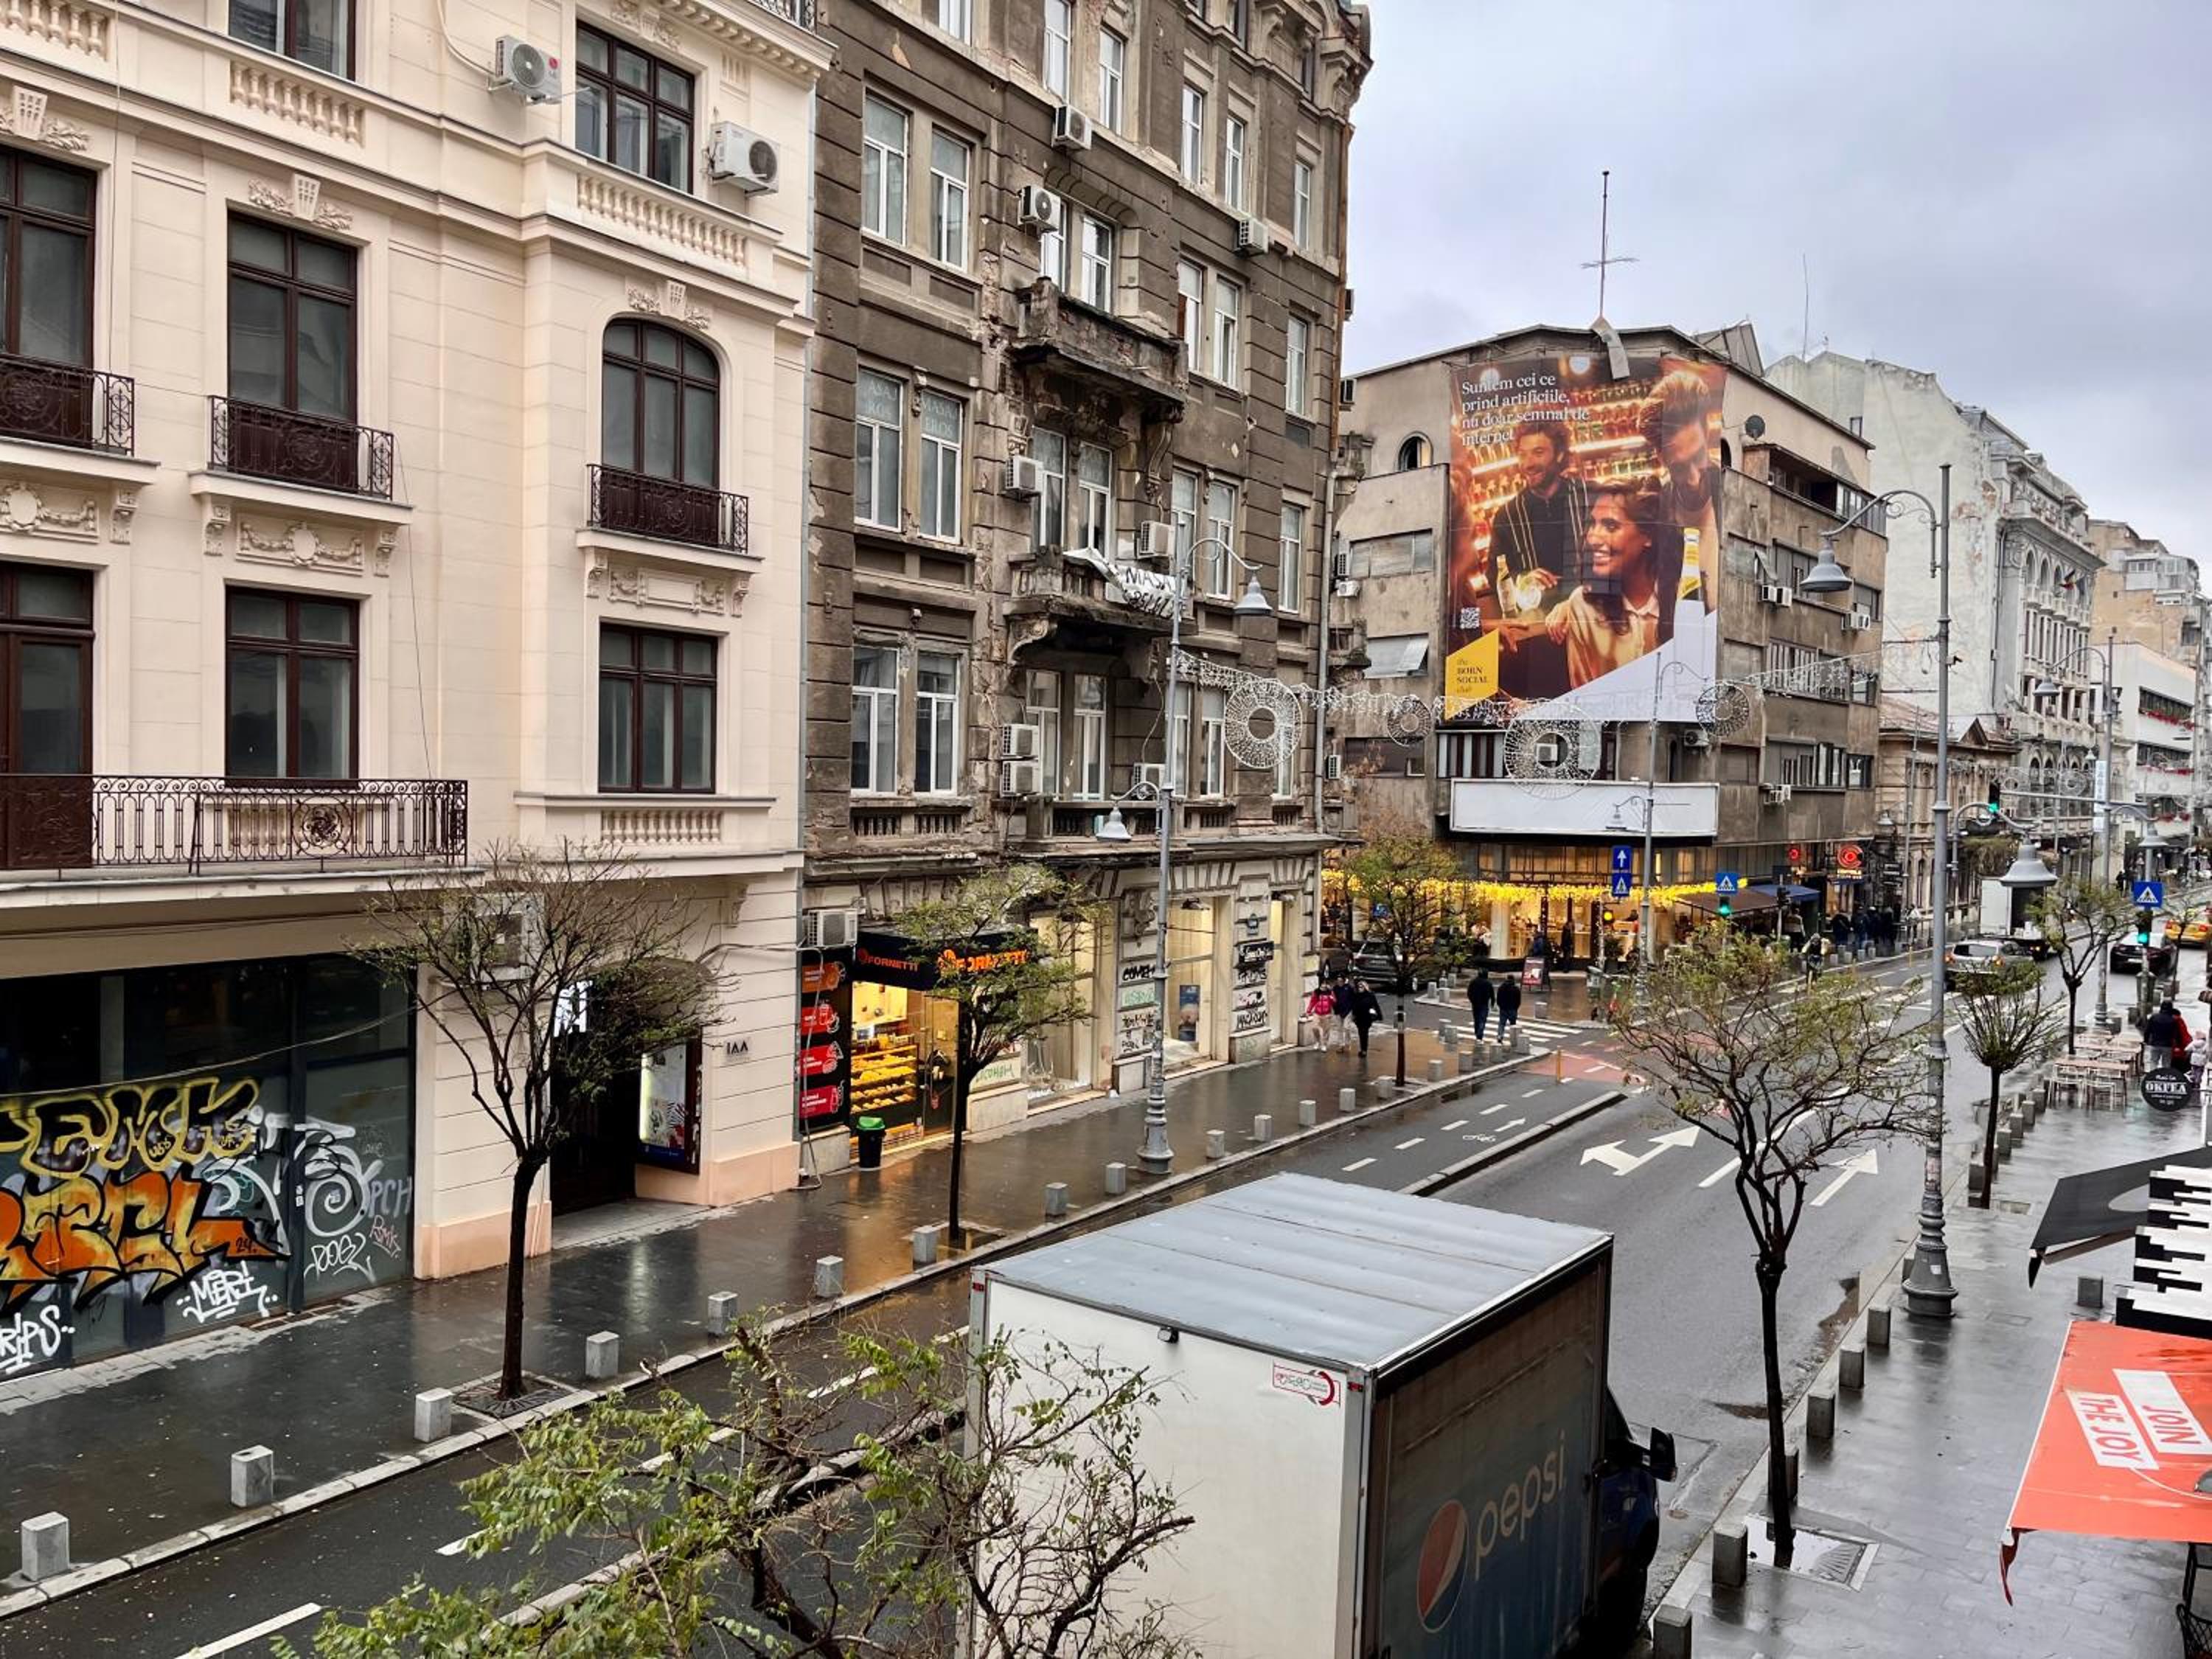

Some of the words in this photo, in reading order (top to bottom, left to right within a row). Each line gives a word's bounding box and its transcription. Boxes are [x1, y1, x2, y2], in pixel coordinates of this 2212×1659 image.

[1462, 377, 1512, 394] Suntem
[1516, 372, 1537, 388] cei
[1539, 375, 1556, 386] ce
[1462, 394, 1499, 415] prind
[1462, 418, 1479, 429] nu
[1482, 411, 1513, 426] doar
[1516, 407, 1569, 422] semnal
[1572, 407, 1590, 421] de
[868, 955, 919, 972] FORNETTI
[2077, 1397, 2125, 1423] THE
[2141, 1404, 2202, 1445] JOIN
[2090, 1425, 2146, 1461] JOY
[1475, 1427, 1566, 1582] pepsi
